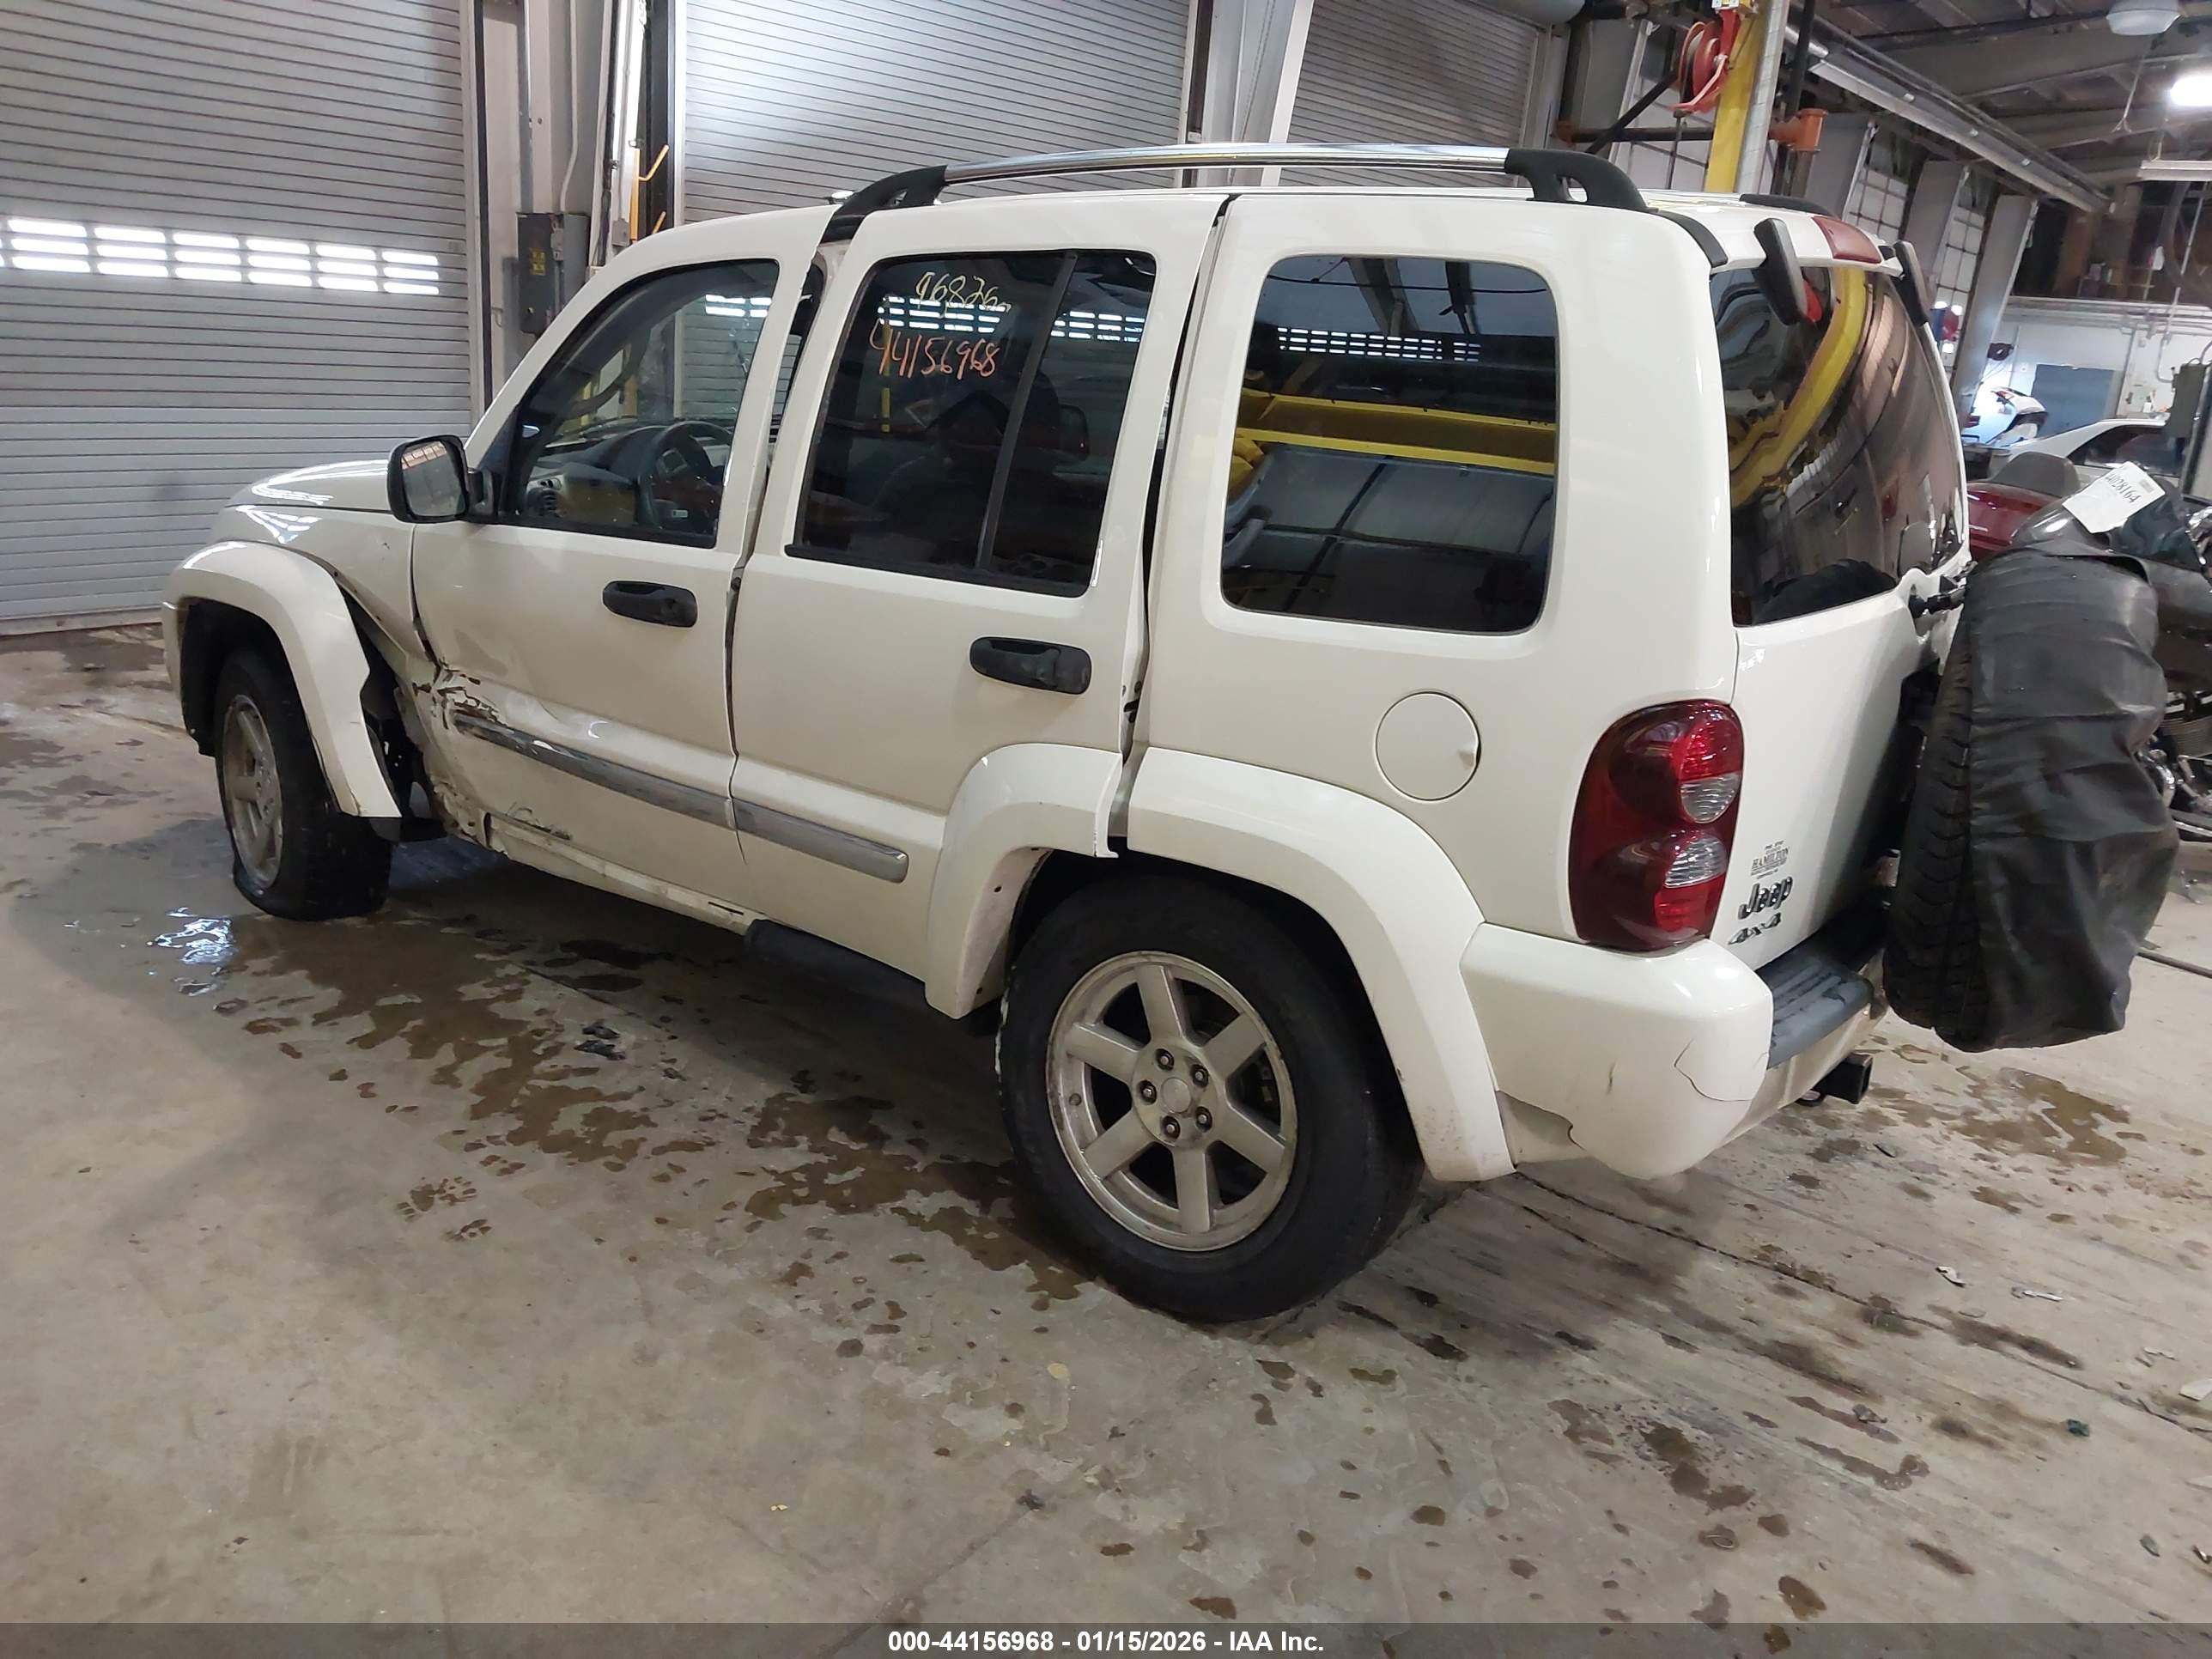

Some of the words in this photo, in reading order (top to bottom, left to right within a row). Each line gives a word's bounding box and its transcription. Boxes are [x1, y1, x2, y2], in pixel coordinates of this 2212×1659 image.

[869, 318, 1001, 380] 44156968
[1738, 876, 1793, 921] Jeep
[1728, 912, 1782, 945] 4x4
